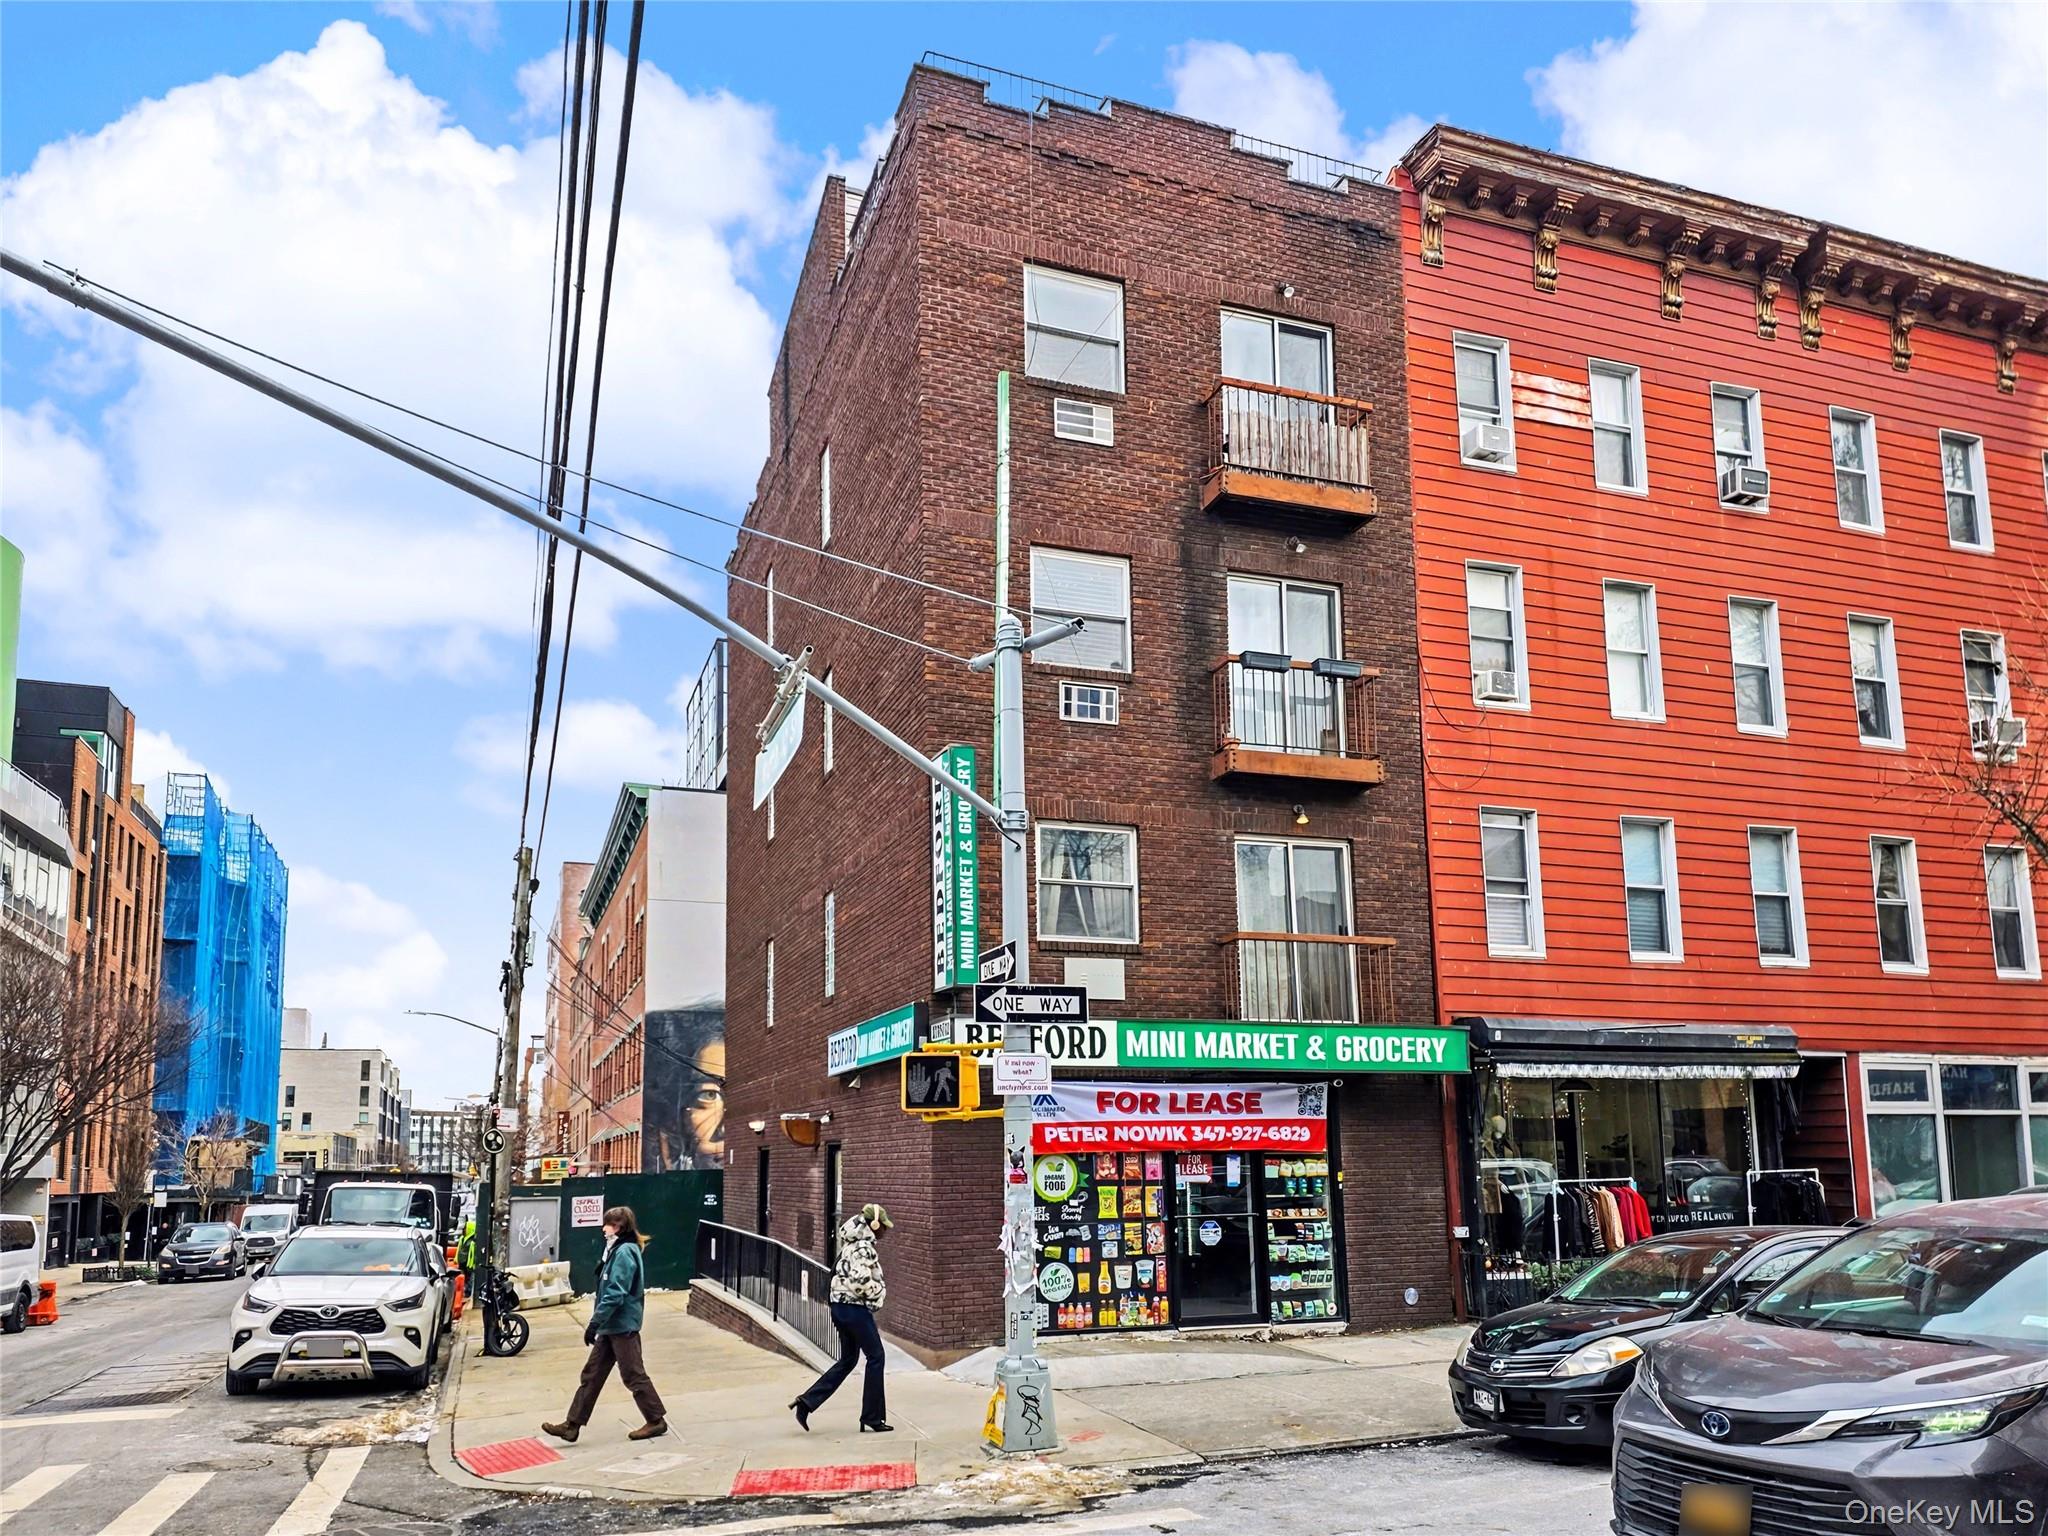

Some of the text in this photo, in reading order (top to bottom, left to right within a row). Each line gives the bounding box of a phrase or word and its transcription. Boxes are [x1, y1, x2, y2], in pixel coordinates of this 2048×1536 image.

[959, 839, 973, 853] &
[959, 857, 974, 926] MARKET
[960, 930, 975, 970] MINI
[983, 954, 1011, 978] ONE WAY
[992, 996, 1073, 1013] ONE WAY
[965, 1024, 1448, 1063] BEFORD MINI MARKET & GROCERY
[1096, 1091, 1264, 1115] FOR LEASE
[1044, 1125, 1311, 1143] PETER NOWIK 347-927-6829
[1187, 1154, 1202, 1164] FOR
[1181, 1163, 1208, 1175] LEASE
[1044, 1181, 1066, 1191] FOOD
[573, 1205, 600, 1213] CLOSED
[1042, 1273, 1071, 1288] 100%
